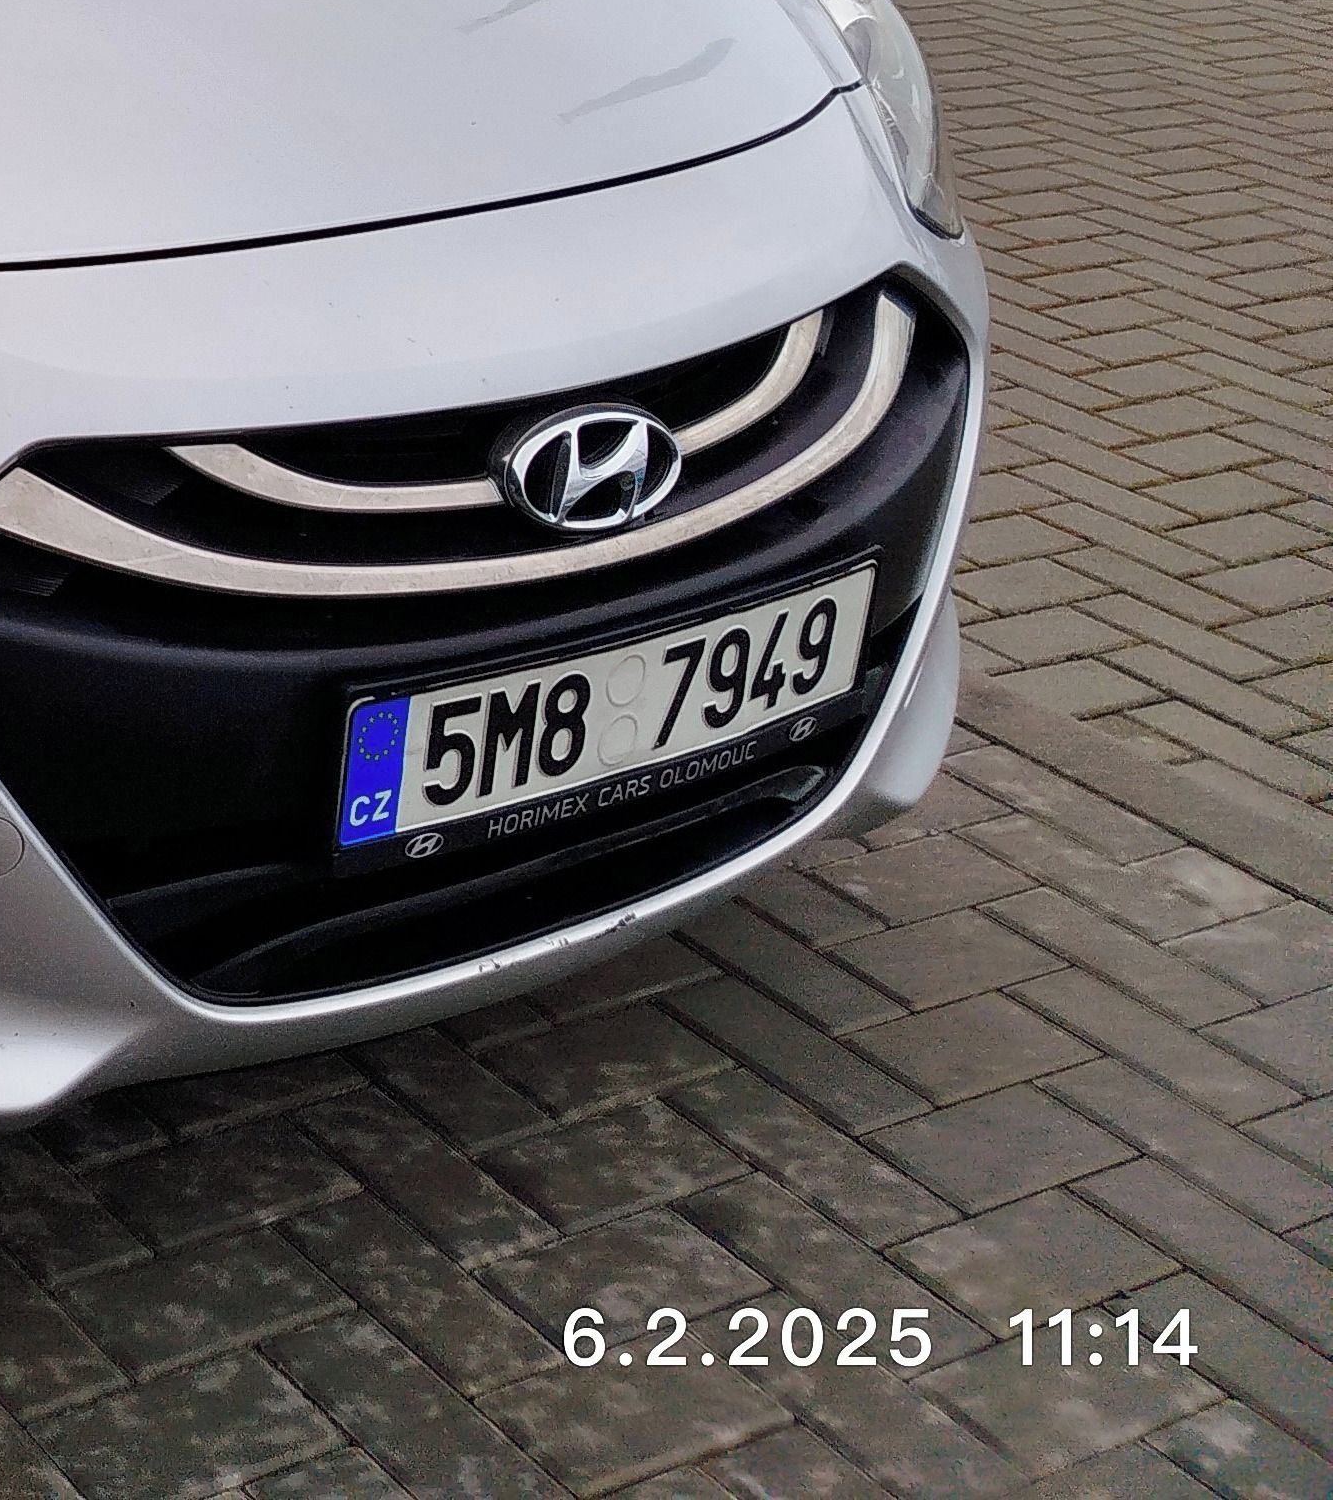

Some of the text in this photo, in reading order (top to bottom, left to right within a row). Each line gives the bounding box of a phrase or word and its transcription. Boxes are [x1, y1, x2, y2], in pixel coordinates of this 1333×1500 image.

[422, 595, 838, 807] 5M8 7949
[349, 786, 392, 827] CZ
[486, 740, 758, 839] HORIMEX CARS OLOMOUC
